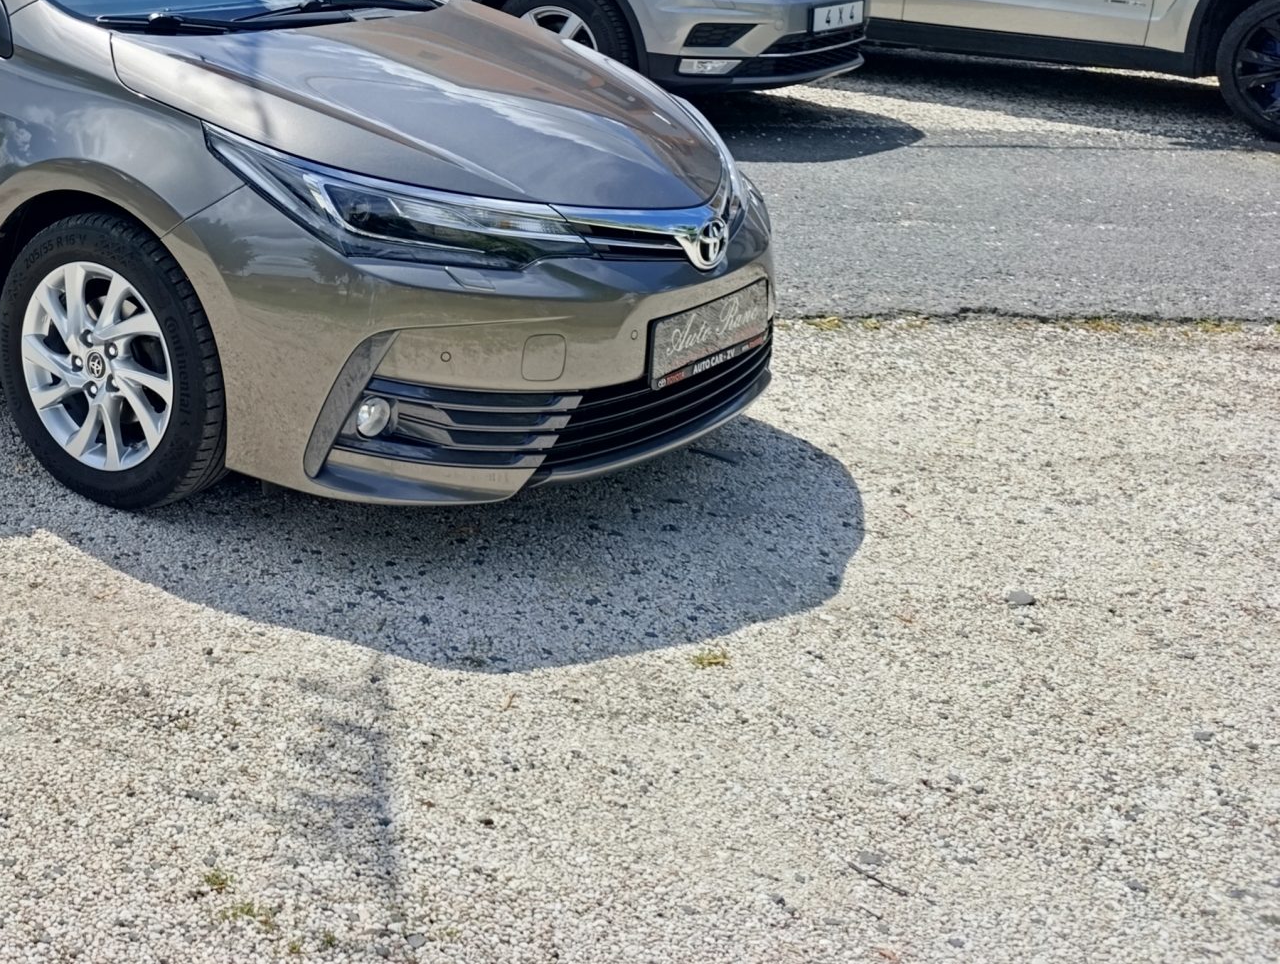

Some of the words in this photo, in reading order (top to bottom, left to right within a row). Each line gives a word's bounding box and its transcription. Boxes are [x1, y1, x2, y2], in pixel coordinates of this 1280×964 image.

[666, 313, 712, 356] Auto
[165, 316, 192, 416] Continental
[692, 359, 710, 375] AUTO
[710, 353, 723, 367] CAR
